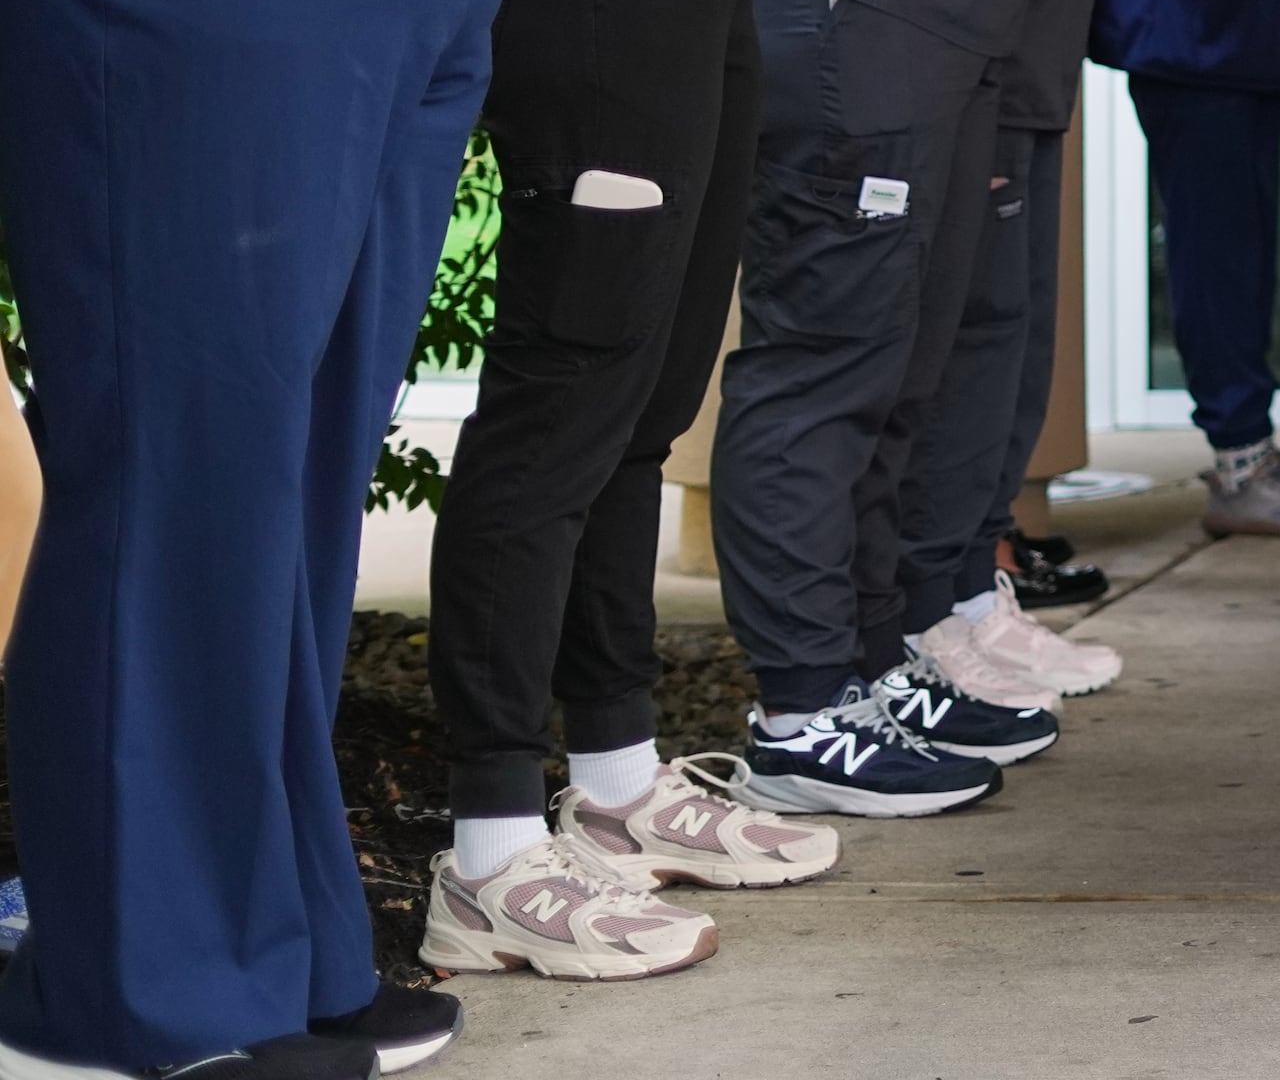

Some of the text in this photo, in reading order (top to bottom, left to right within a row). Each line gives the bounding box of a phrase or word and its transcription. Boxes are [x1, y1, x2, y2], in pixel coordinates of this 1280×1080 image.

[896, 688, 953, 729] N
[818, 732, 880, 776] N
[668, 804, 713, 837] N
[521, 889, 569, 922] N
